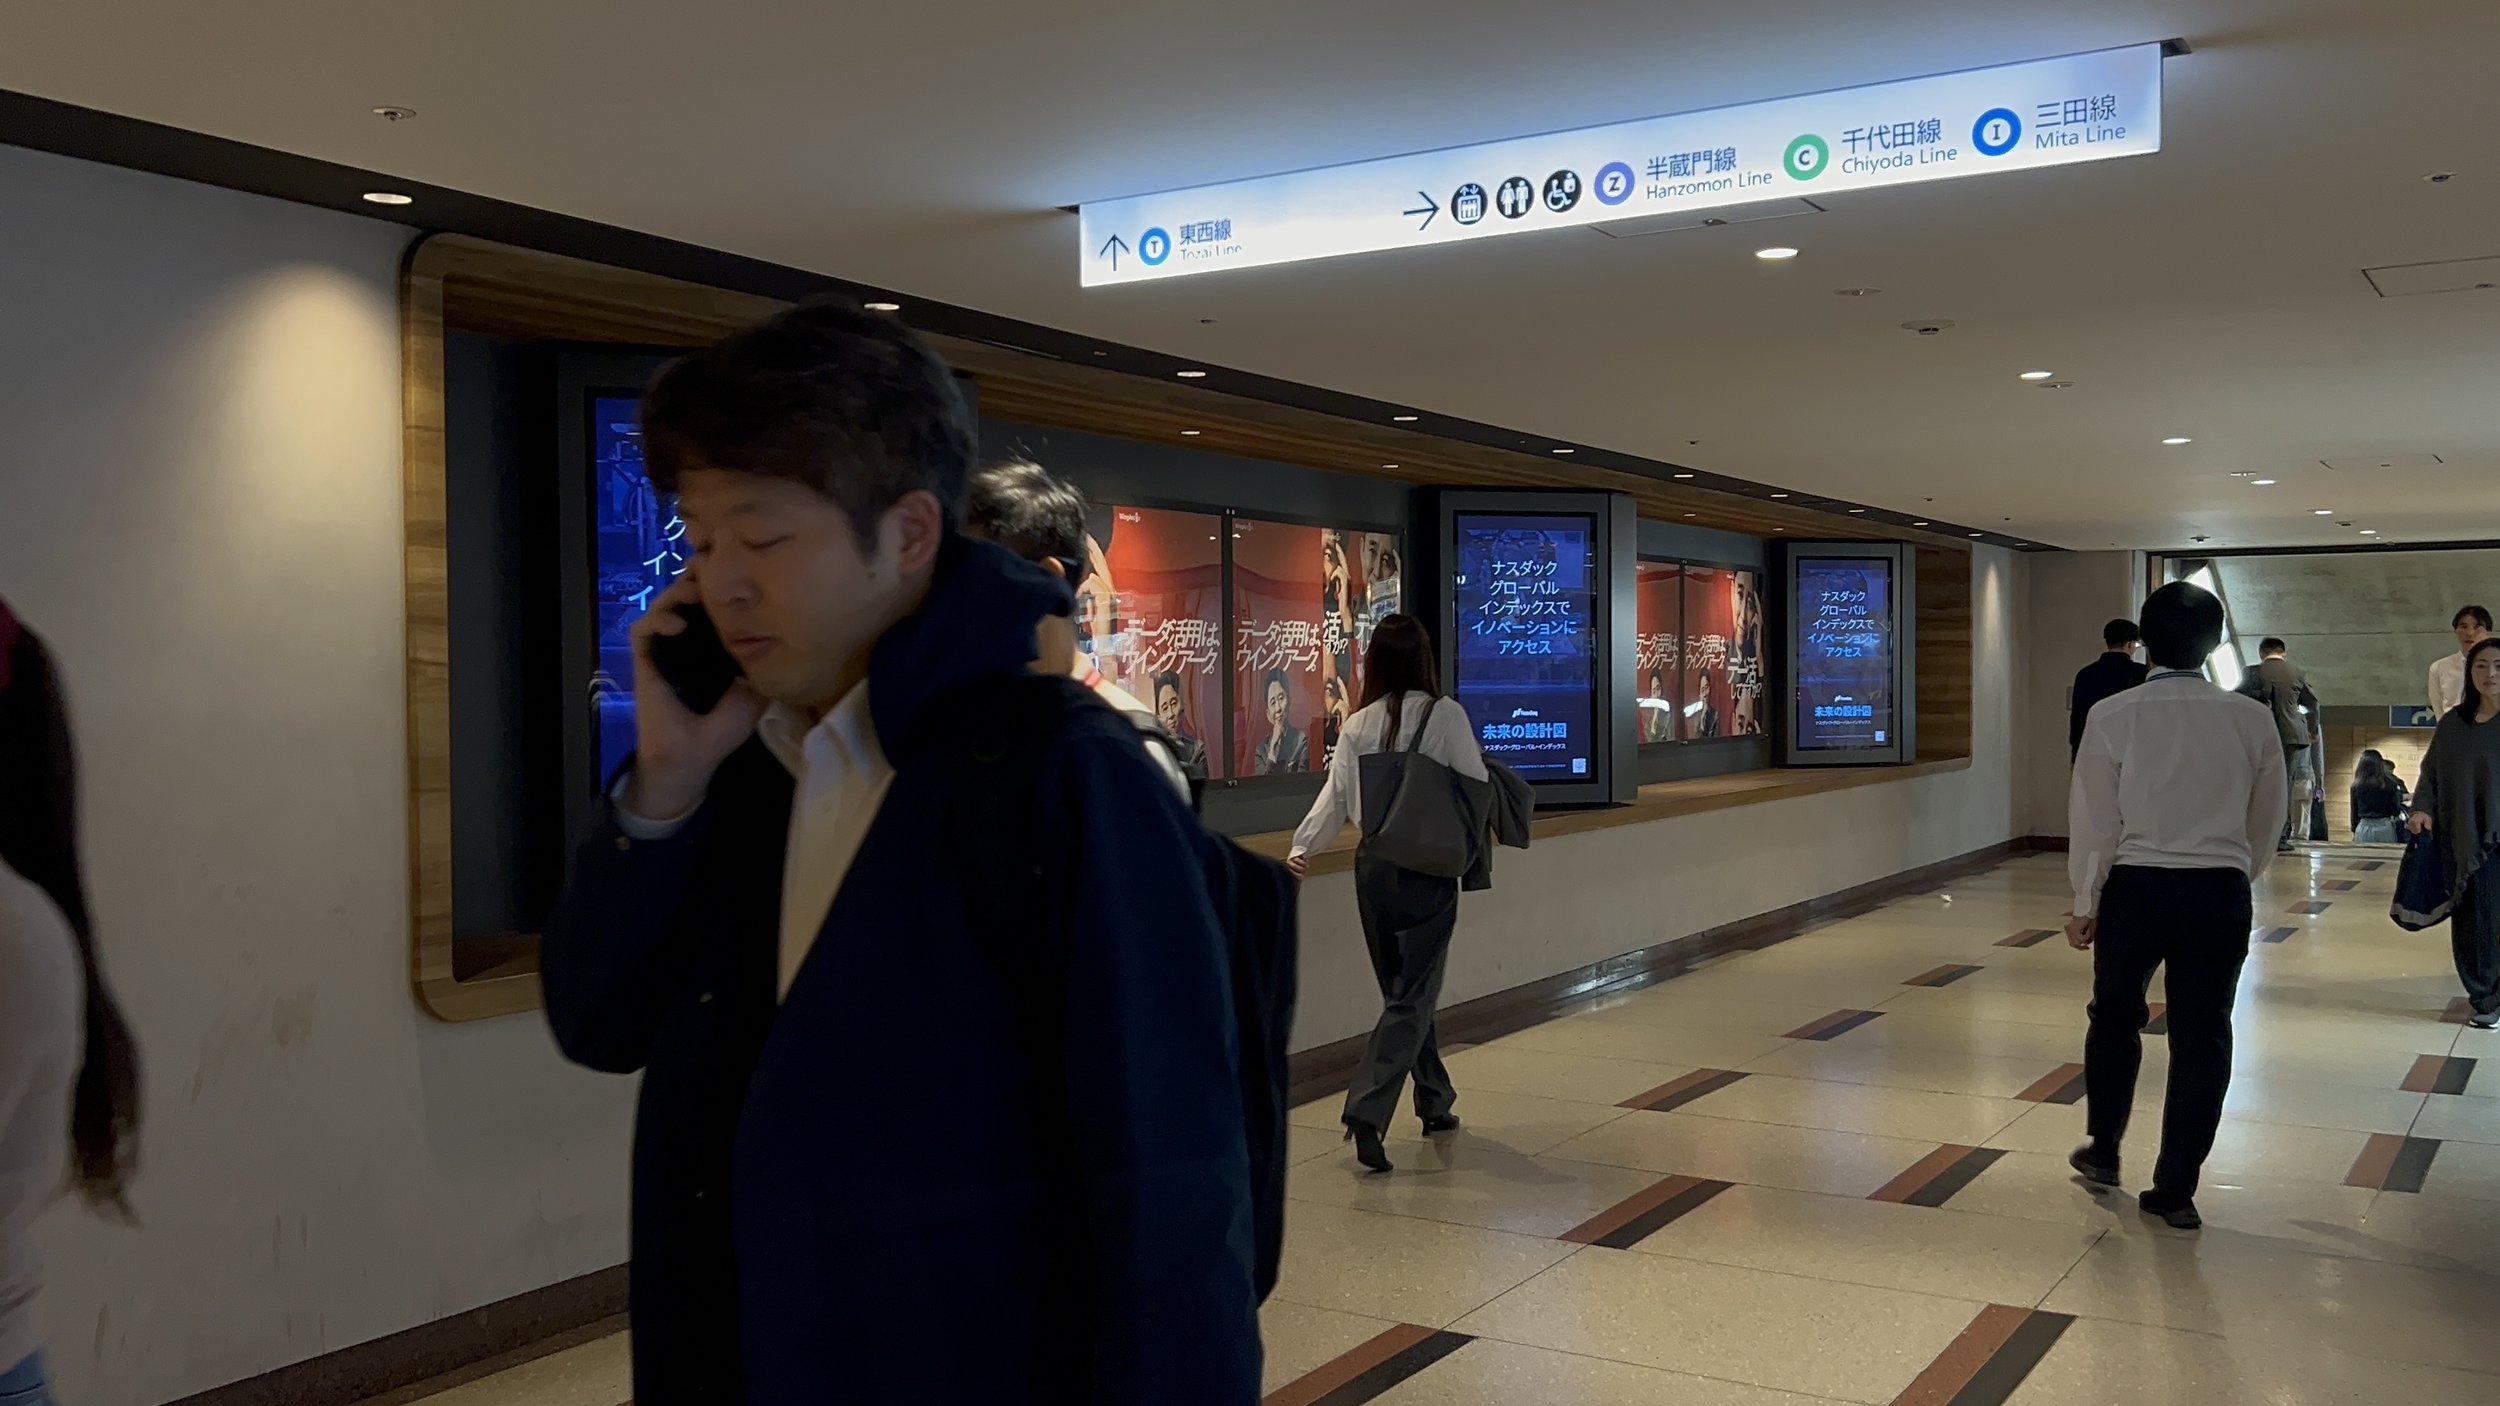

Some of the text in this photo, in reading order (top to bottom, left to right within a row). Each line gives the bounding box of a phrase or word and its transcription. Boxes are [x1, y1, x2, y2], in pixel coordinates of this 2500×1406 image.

[2035, 93, 2117, 130] 三田線
[1841, 117, 1942, 155] 千代田線
[2035, 124, 2127, 150] Mita Line
[1646, 146, 1737, 182] 半蔵門線
[1798, 149, 1810, 166] C
[1842, 146, 1958, 176] Chiyoda Line
[1608, 176, 1621, 193] Z
[1646, 170, 1773, 200] Hanzomon Line
[1179, 217, 1232, 246] 東西線
[1151, 240, 1159, 254] T
[1180, 243, 1242, 261] Tozai Line
[1491, 560, 1557, 577] ナスダック
[1489, 580, 1560, 596] グローバル
[1821, 590, 1866, 602] ナスダック
[1479, 600, 1571, 616] インデックスで
[1820, 604, 1867, 616] グローバル
[1471, 620, 1578, 635] イノベーションに
[1812, 618, 1874, 630] インデックスで
[1807, 633, 1880, 644] イノベーションに
[1498, 640, 1552, 655] アクセス
[1825, 646, 1862, 658] アクセス
[1814, 705, 1872, 718] 未来の設計図
[1483, 722, 1567, 740] 未来の設計図
